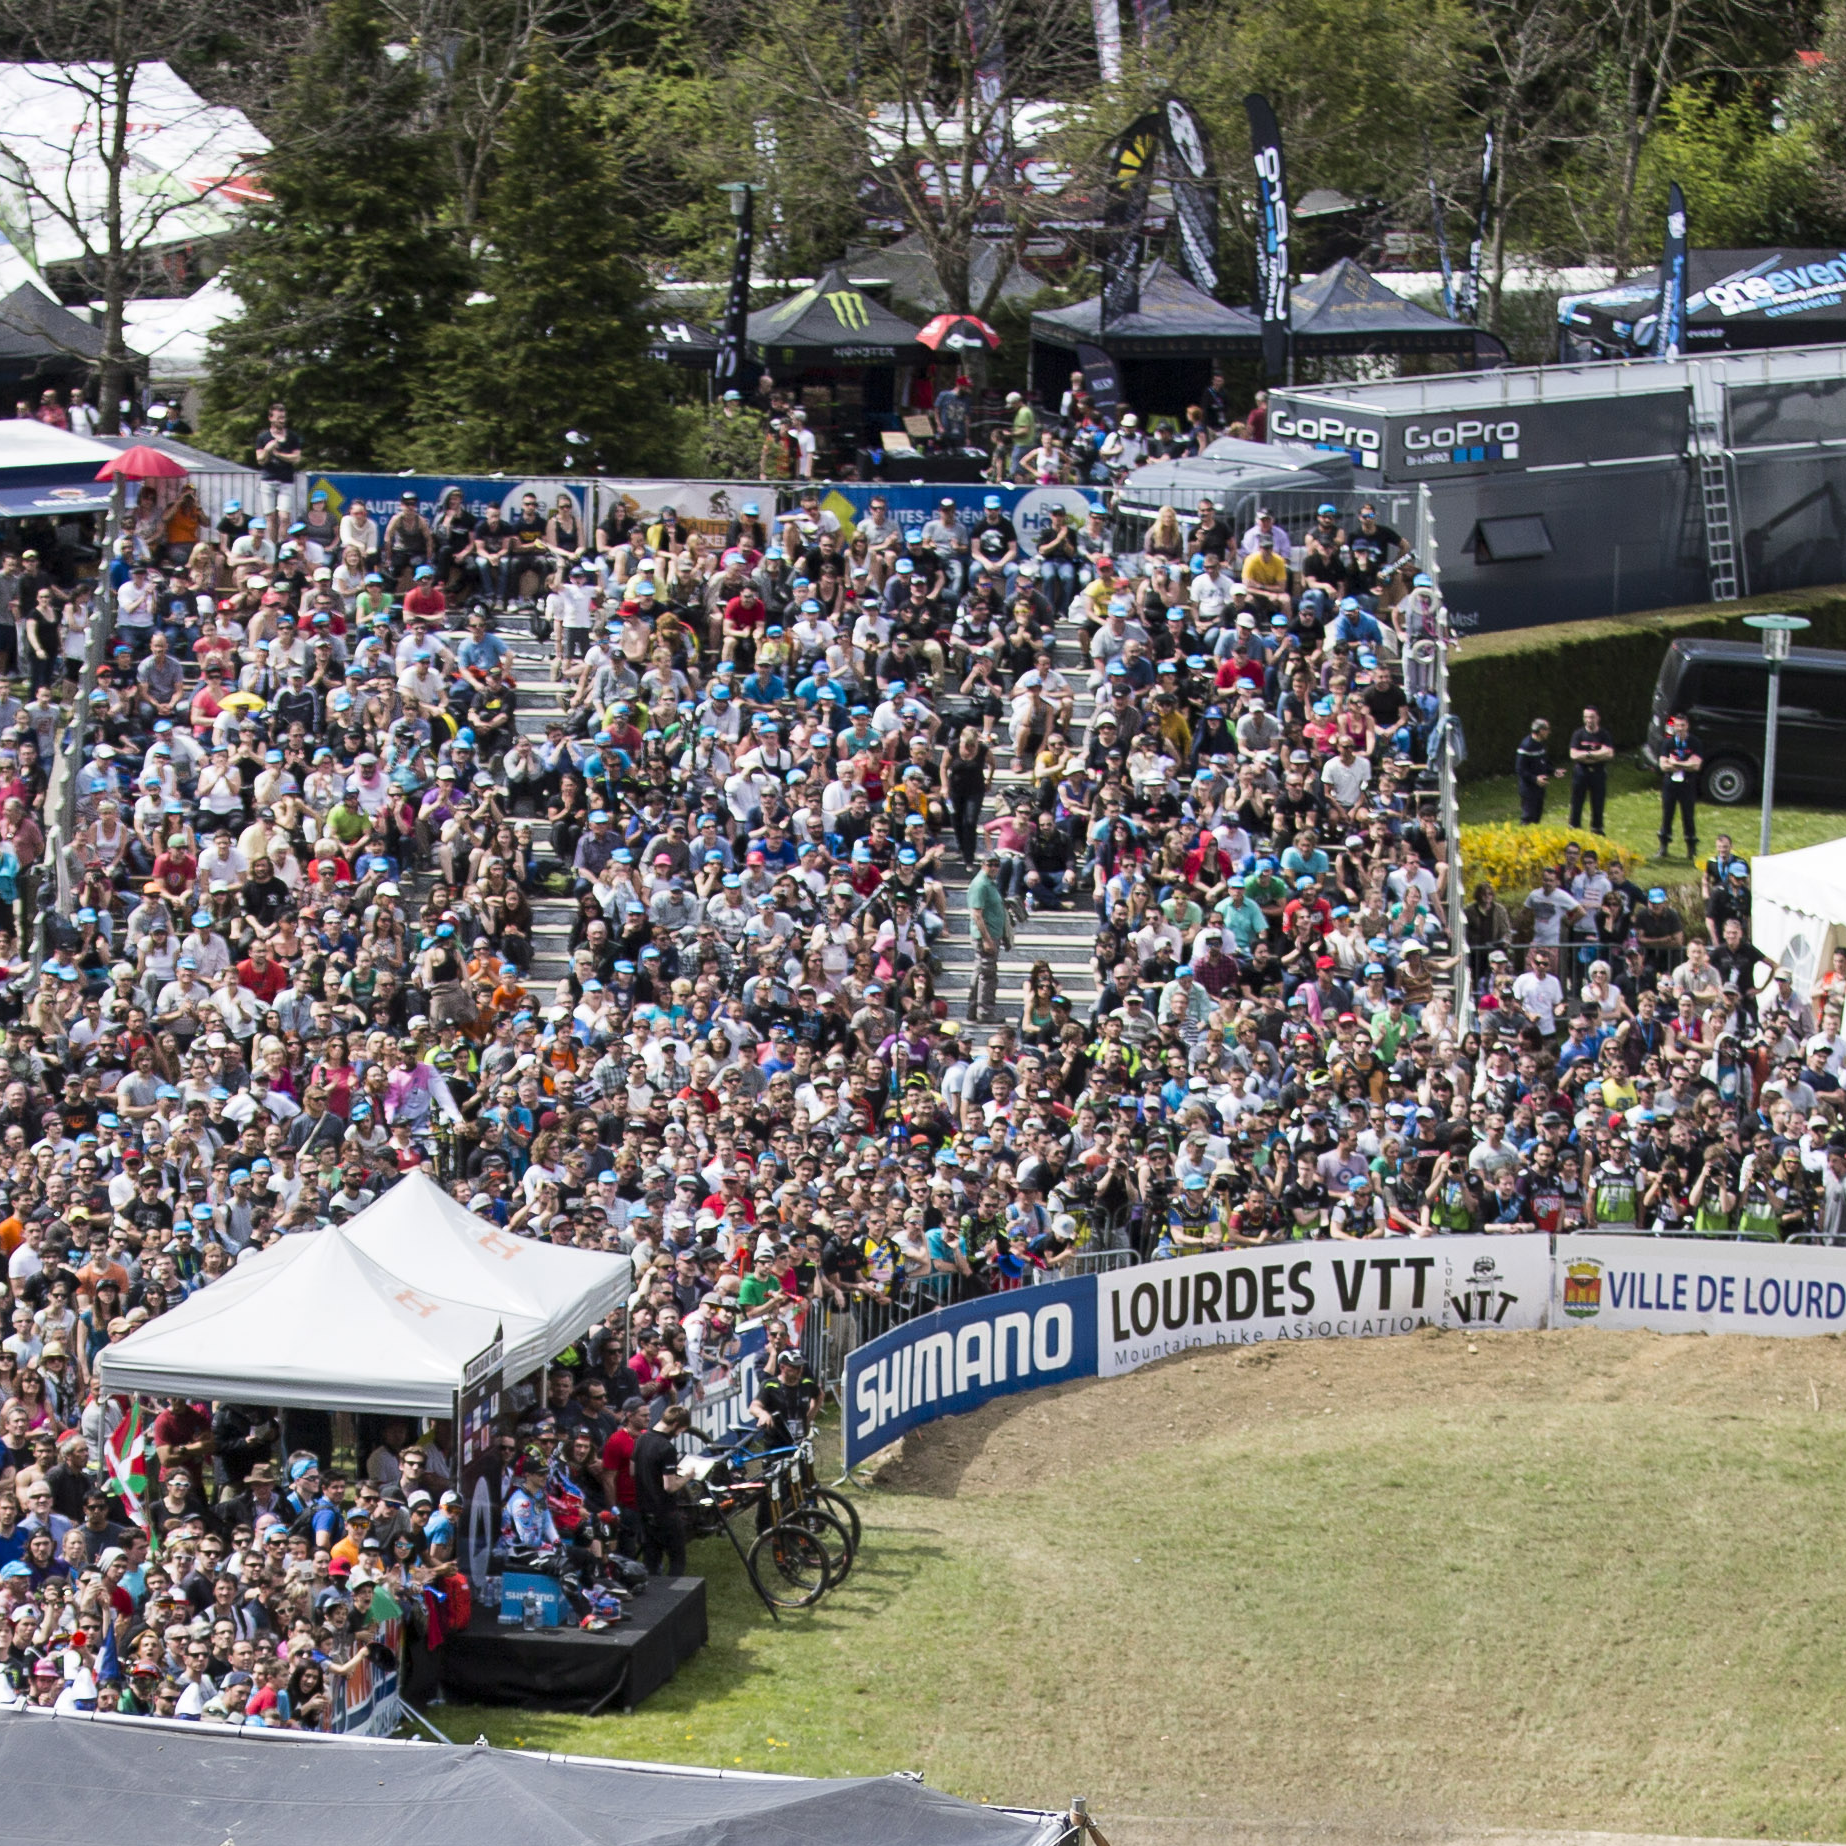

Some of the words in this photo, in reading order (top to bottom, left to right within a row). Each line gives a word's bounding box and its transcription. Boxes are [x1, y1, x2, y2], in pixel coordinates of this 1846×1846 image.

[1271, 411, 1380, 449] GoPro
[1404, 421, 1520, 450] GoPro
[1110, 1260, 1315, 1342] LOURDES
[1331, 1257, 1435, 1313] VTT
[1450, 1290, 1519, 1324] VTT
[1607, 1271, 1687, 1312] VILLE
[1696, 1275, 1735, 1313] DE
[1115, 1332, 1202, 1366] Mountain
[1217, 1330, 1263, 1347] bike
[856, 1303, 1073, 1440] SHIMANO
